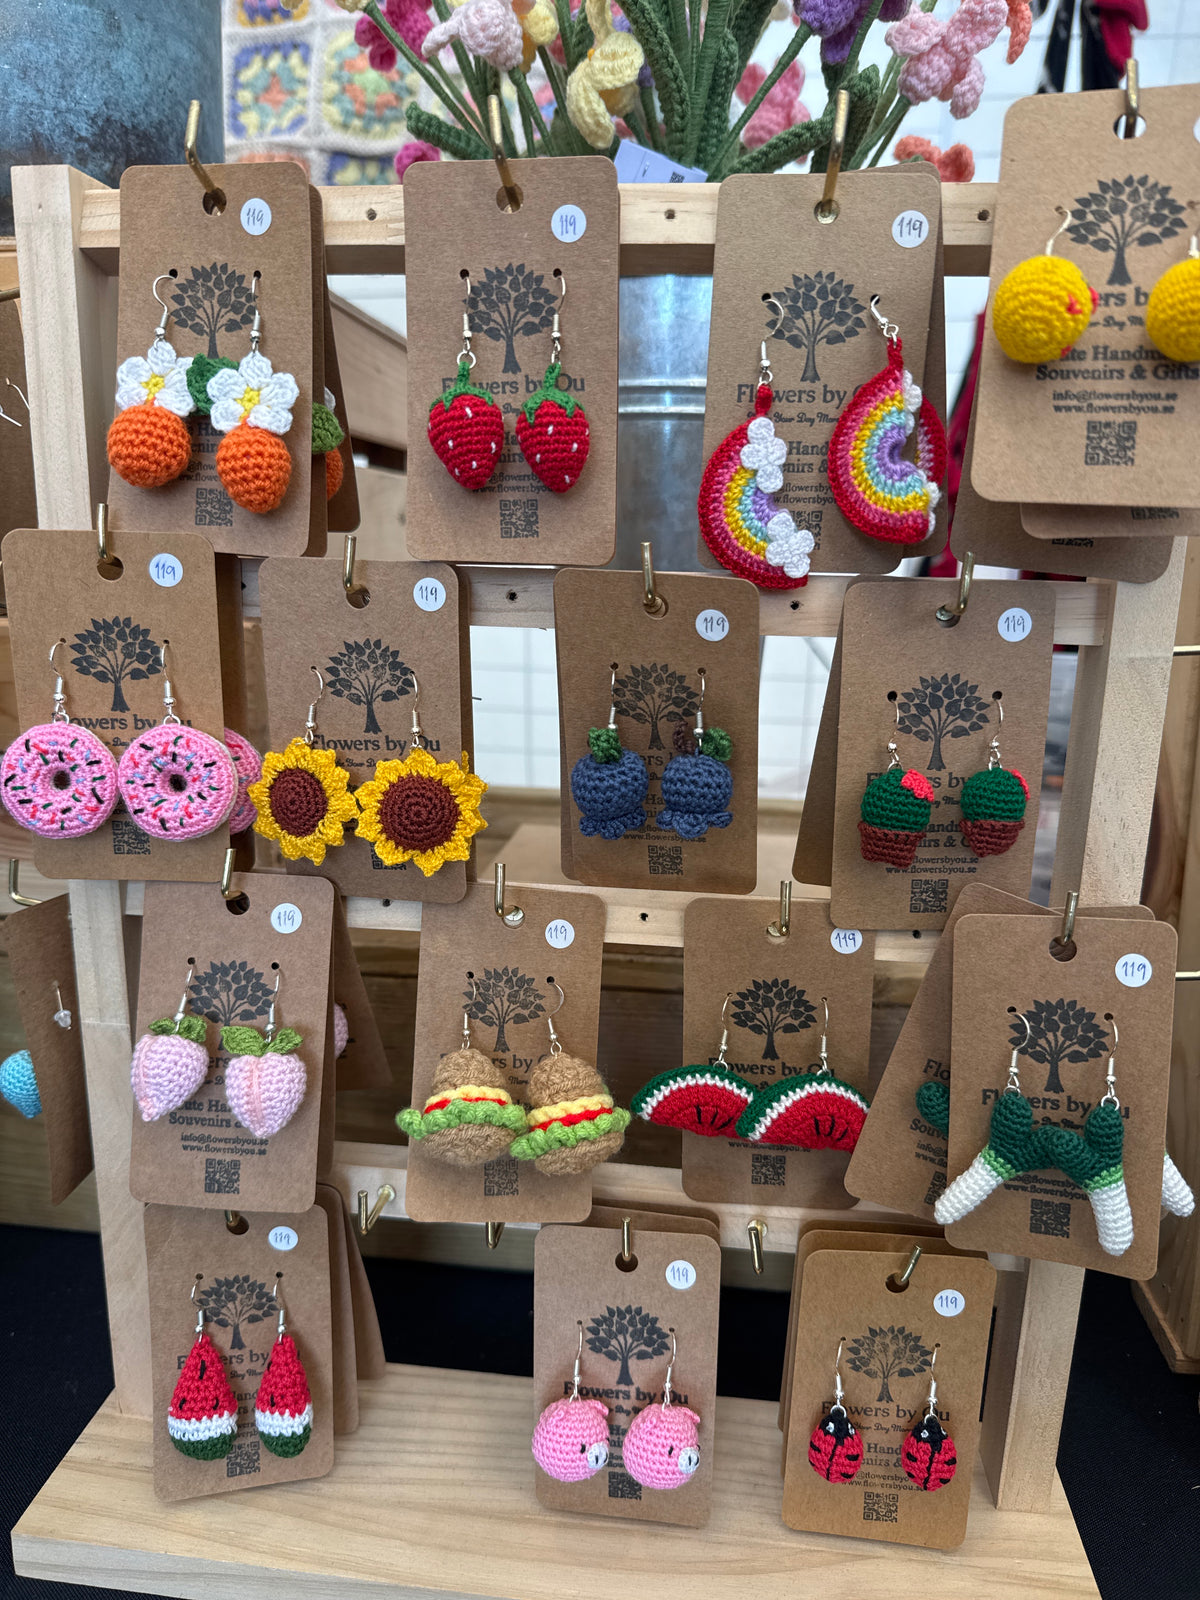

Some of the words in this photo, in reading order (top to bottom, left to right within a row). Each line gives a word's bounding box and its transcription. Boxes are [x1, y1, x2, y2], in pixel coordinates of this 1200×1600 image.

[247, 208, 264, 226] 119
[559, 214, 576, 236] 119
[898, 217, 923, 238] 119
[1036, 363, 1125, 381] Souvenirs
[1129, 363, 1147, 381] &
[1152, 362, 1200, 381] Gifts
[736, 384, 817, 404] Flwers
[822, 384, 848, 410] by
[1052, 390, 1178, 404] info@flowersbyou.se
[1053, 402, 1175, 415] www.flowersbyou.se
[787, 440, 829, 457] Hand
[155, 560, 176, 581] 119
[418, 586, 438, 602] 119
[703, 616, 726, 633] 119
[1004, 615, 1025, 633] 119
[385, 735, 407, 757] by
[944, 835, 957, 848] &
[886, 865, 977, 875] www.flowersbyou.se
[277, 910, 295, 927] 119
[548, 924, 568, 942] 119
[835, 932, 857, 949] 119
[1122, 961, 1147, 981] 119
[512, 1054, 533, 1073] by
[1066, 1095, 1092, 1118] by
[169, 1111, 232, 1128] Souvenirs
[181, 1132, 269, 1147] info@flowersbyou.se
[182, 1144, 267, 1156] www.flowersbyou.se
[273, 1231, 290, 1246] 119
[671, 1265, 688, 1283] 119
[939, 1295, 957, 1311] 119
[250, 1349, 269, 1366] by
[635, 1386, 657, 1405] by
[896, 1405, 917, 1423] by
[867, 1442, 902, 1456] Hand
